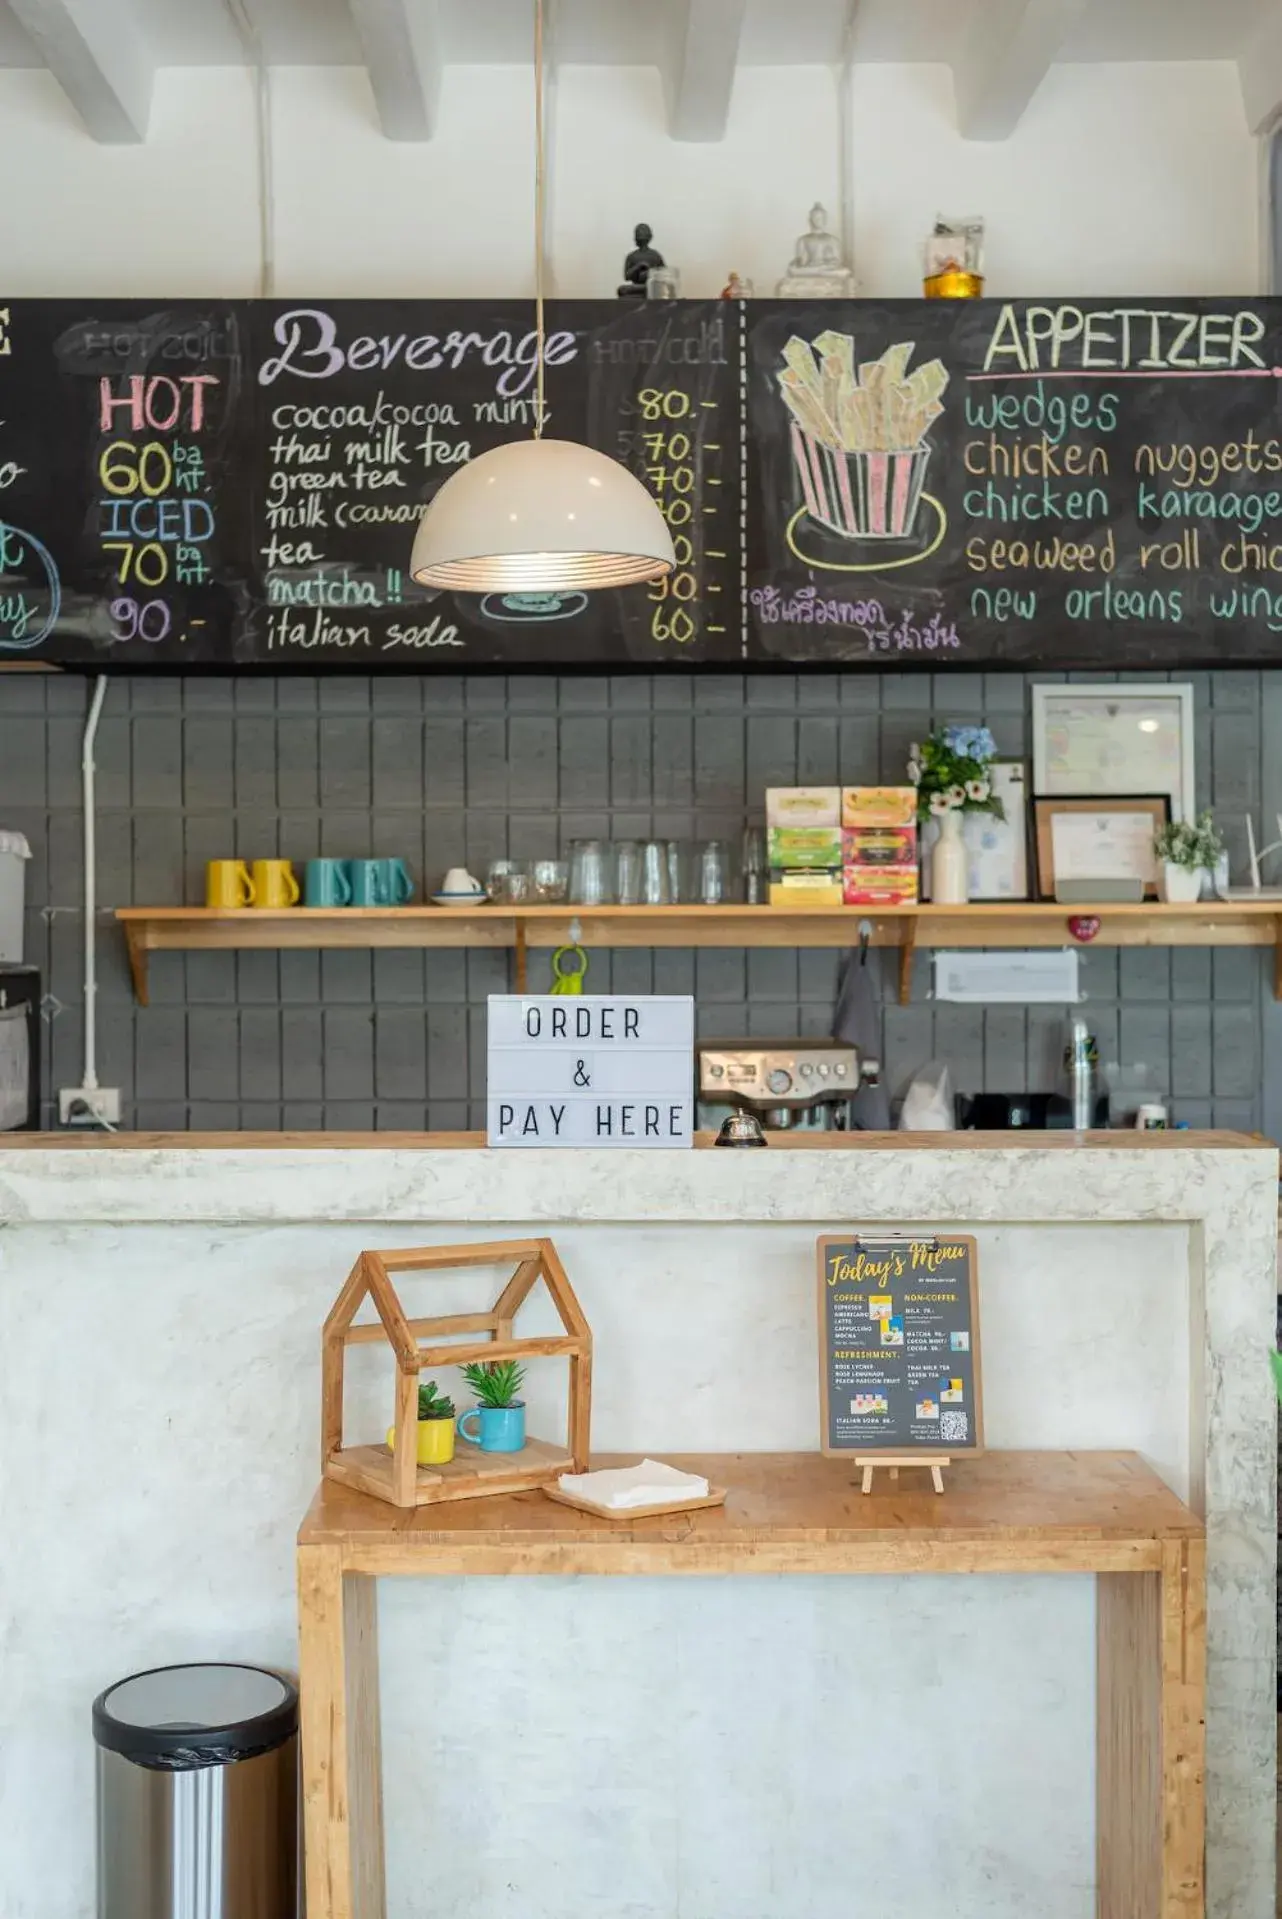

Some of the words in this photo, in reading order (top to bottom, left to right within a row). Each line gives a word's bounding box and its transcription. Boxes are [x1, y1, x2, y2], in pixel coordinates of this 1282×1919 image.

[259, 309, 577, 396] Beverage
[983, 305, 1266, 372] APPETIZER
[100, 374, 220, 432] HOT
[965, 379, 1120, 443] wedges
[269, 433, 331, 464] thai
[344, 424, 412, 464] milk
[416, 424, 472, 467] tea
[963, 429, 1109, 477] chicken
[1135, 428, 1282, 488] nuggets
[100, 441, 172, 496] 60
[266, 471, 348, 507] green
[351, 462, 406, 489] tea
[100, 499, 215, 542] ICED
[265, 492, 328, 530] milk
[963, 481, 1109, 522] chicken
[1139, 482, 1282, 534] karaage
[102, 542, 168, 586] 70
[260, 534, 325, 568] tea
[966, 529, 1116, 573] seaweed
[1140, 527, 1200, 570] roll
[970, 587, 1036, 621] new
[1065, 583, 1183, 623] orleans
[266, 607, 372, 650] italian
[381, 615, 466, 651] soda
[526, 1007, 640, 1038] ORDER
[573, 1059, 591, 1087] &
[500, 1104, 566, 1136] PAY
[596, 1105, 683, 1136] HERE
[827, 1252, 906, 1288] Today's
[909, 1241, 966, 1272] Menu
